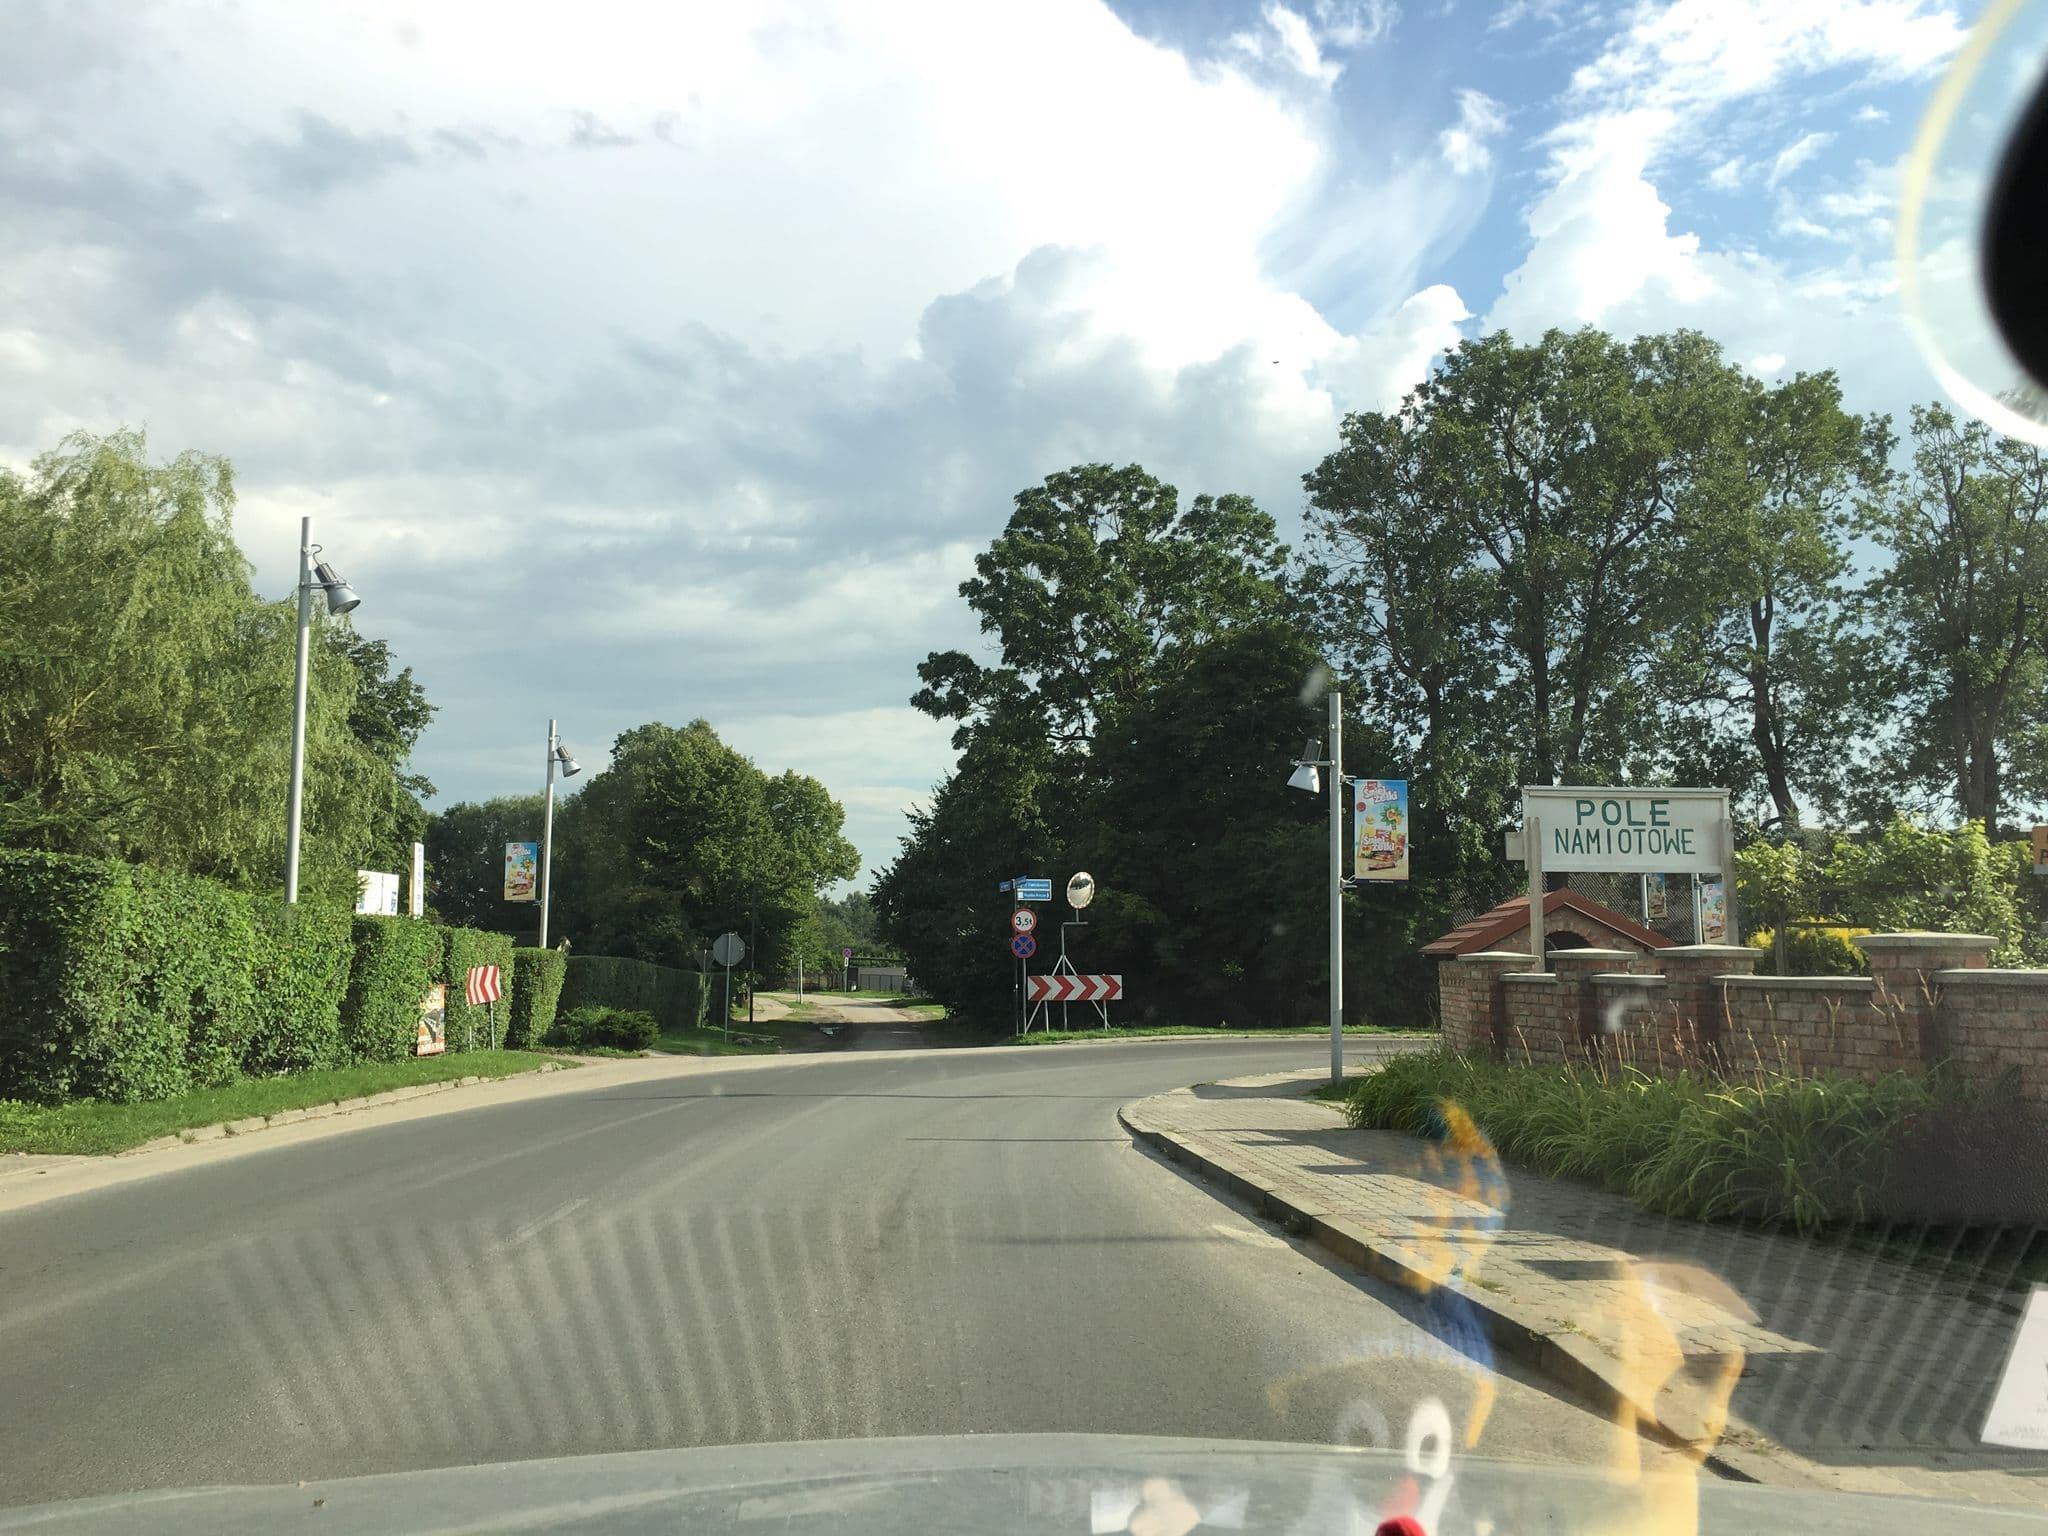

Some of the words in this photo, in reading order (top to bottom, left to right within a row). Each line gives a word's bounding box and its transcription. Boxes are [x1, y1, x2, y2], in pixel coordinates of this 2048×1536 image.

[1575, 799, 1671, 826] POLE
[1554, 827, 1697, 855] NAMIOTOWE
[1016, 917, 1032, 927] 3,5t
